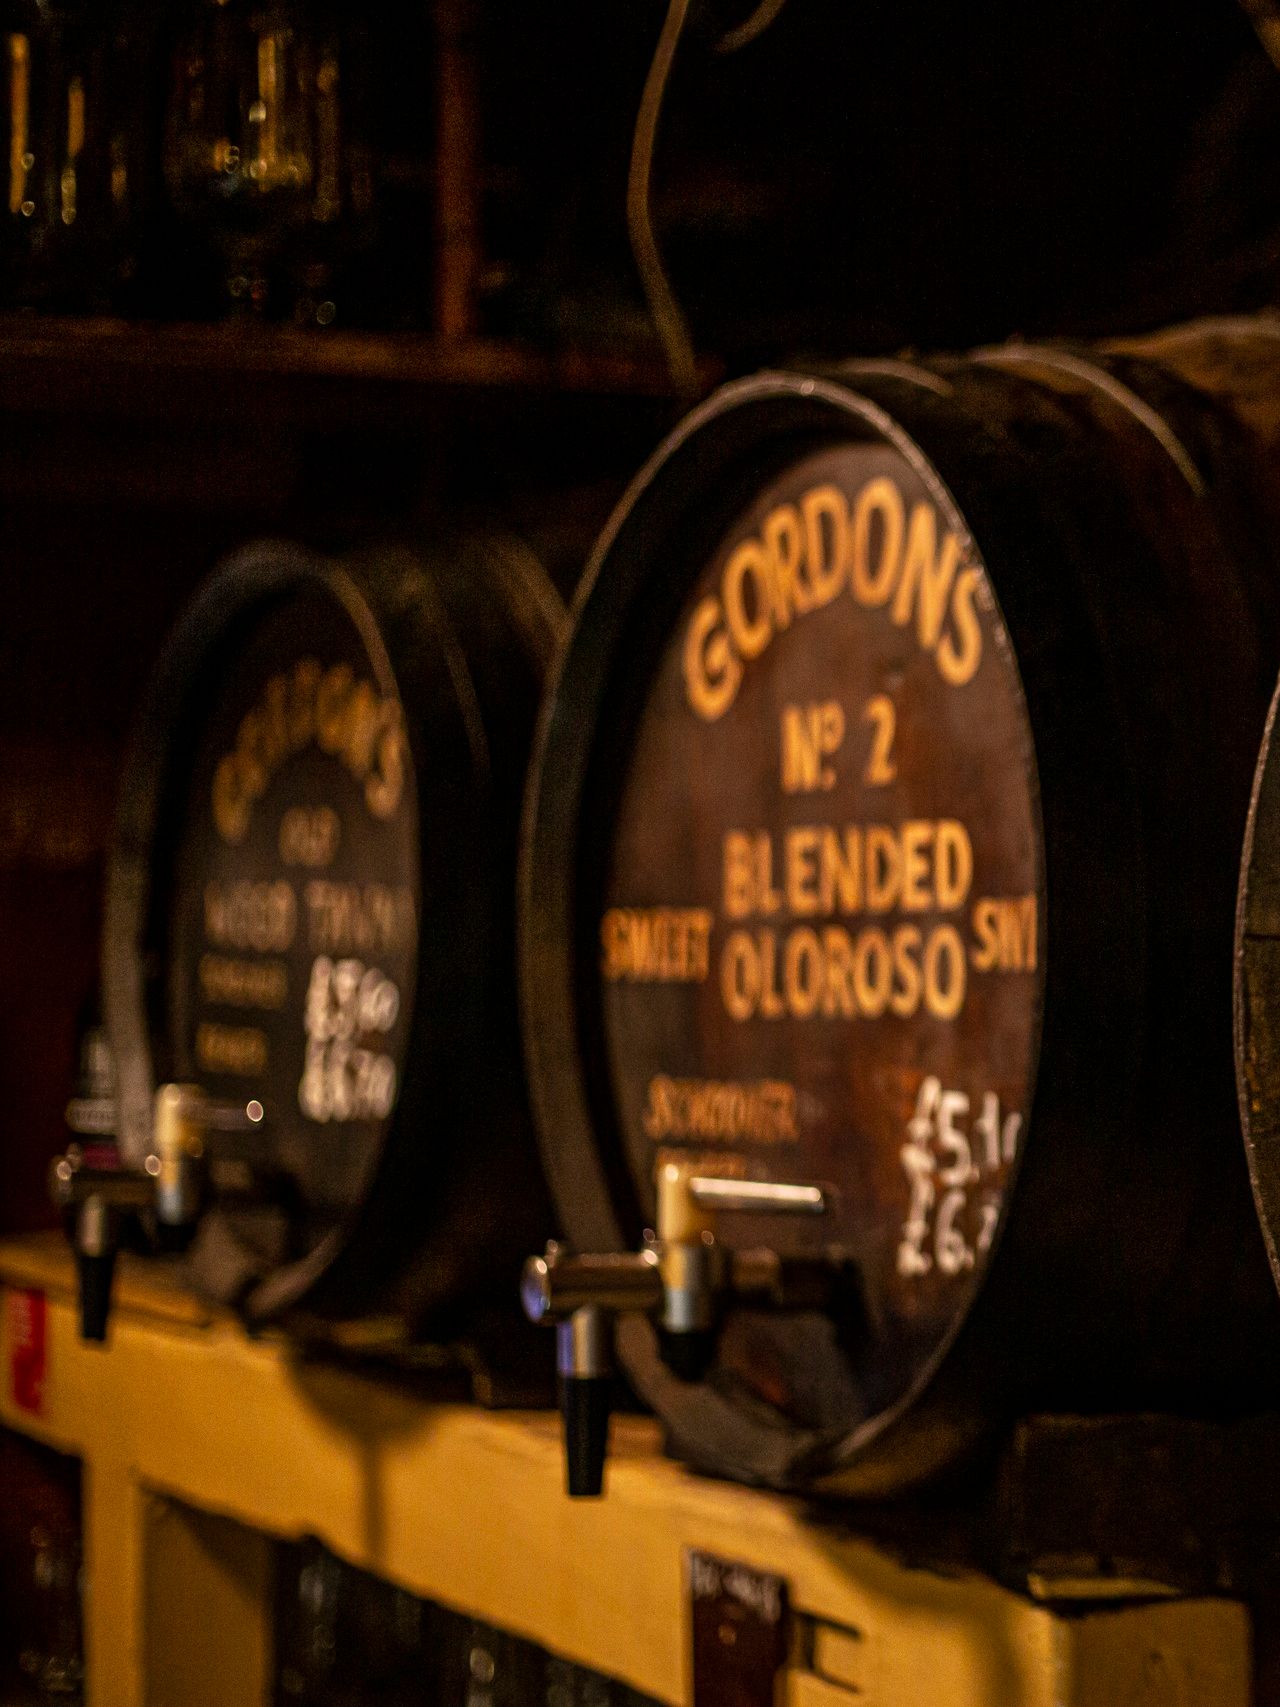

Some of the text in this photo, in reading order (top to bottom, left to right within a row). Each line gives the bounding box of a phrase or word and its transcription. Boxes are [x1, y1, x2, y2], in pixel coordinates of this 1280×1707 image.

[865, 694, 897, 786] 2
[722, 817, 973, 918] BLENDED
[718, 922, 968, 1022] OLOROSO
